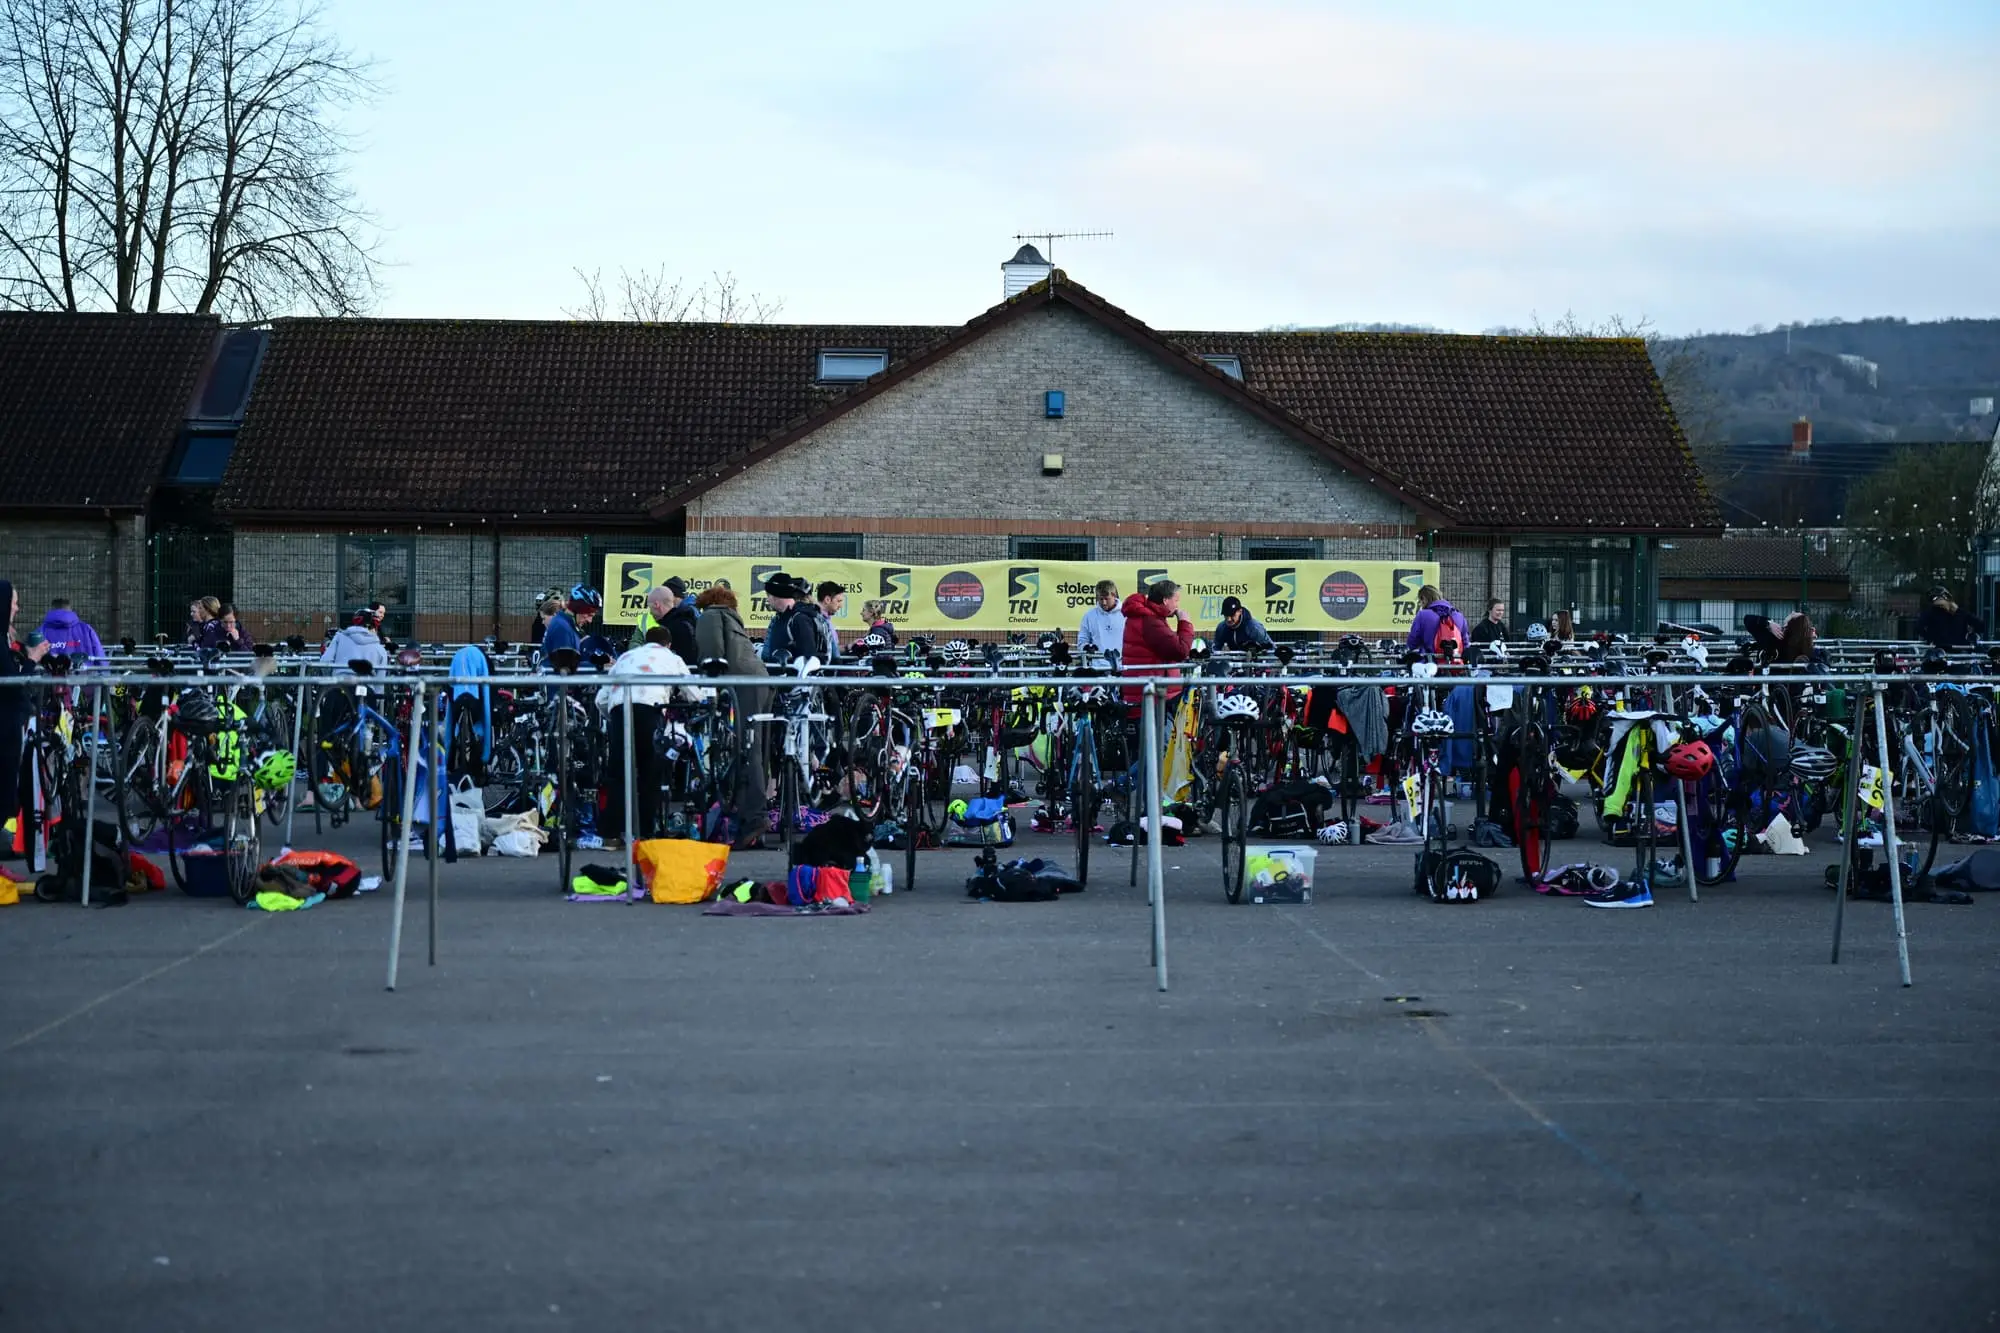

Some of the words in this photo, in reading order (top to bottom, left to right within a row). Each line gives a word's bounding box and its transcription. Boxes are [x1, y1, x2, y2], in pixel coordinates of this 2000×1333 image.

[683, 578, 712, 589] olen
[1186, 583, 1248, 595] THATCHERS
[880, 600, 909, 614] TRI
[1008, 599, 1038, 614] TRI
[1066, 596, 1096, 609] goa
[1199, 596, 1224, 619] ZER
[1265, 600, 1295, 614] TRI
